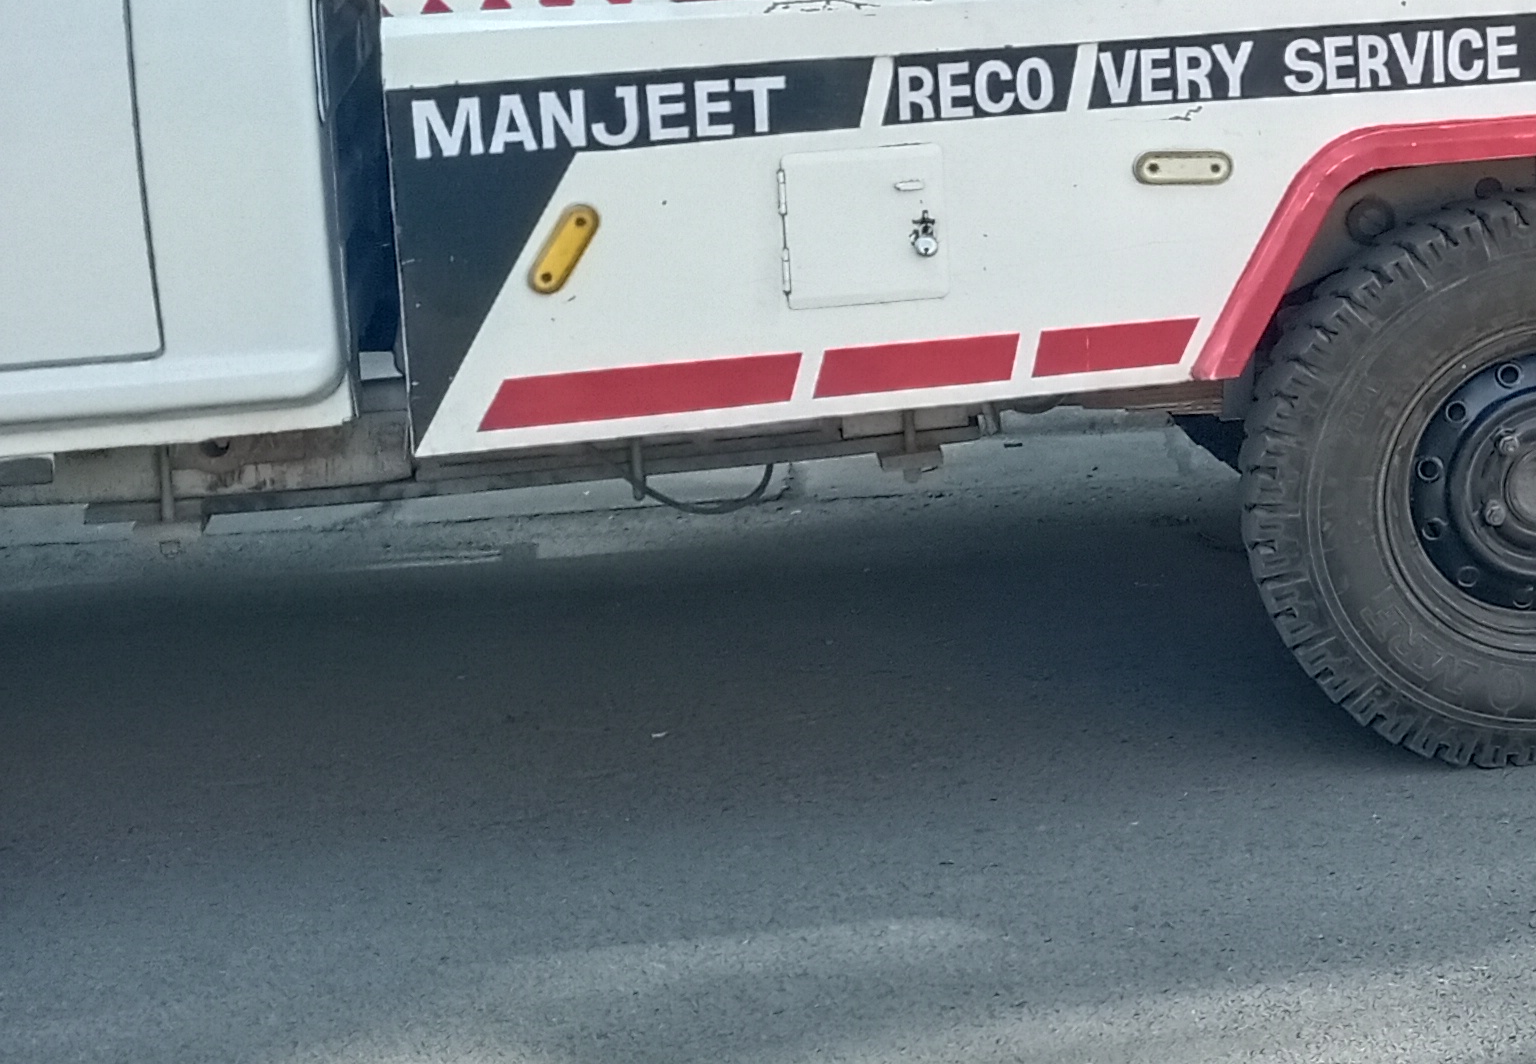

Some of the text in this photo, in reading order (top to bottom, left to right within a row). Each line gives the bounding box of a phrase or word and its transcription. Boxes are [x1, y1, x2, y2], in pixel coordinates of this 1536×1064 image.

[408, 75, 787, 161] MANJEET
[1283, 24, 1520, 94] SERVICE
[1359, 602, 1482, 696] MRF
